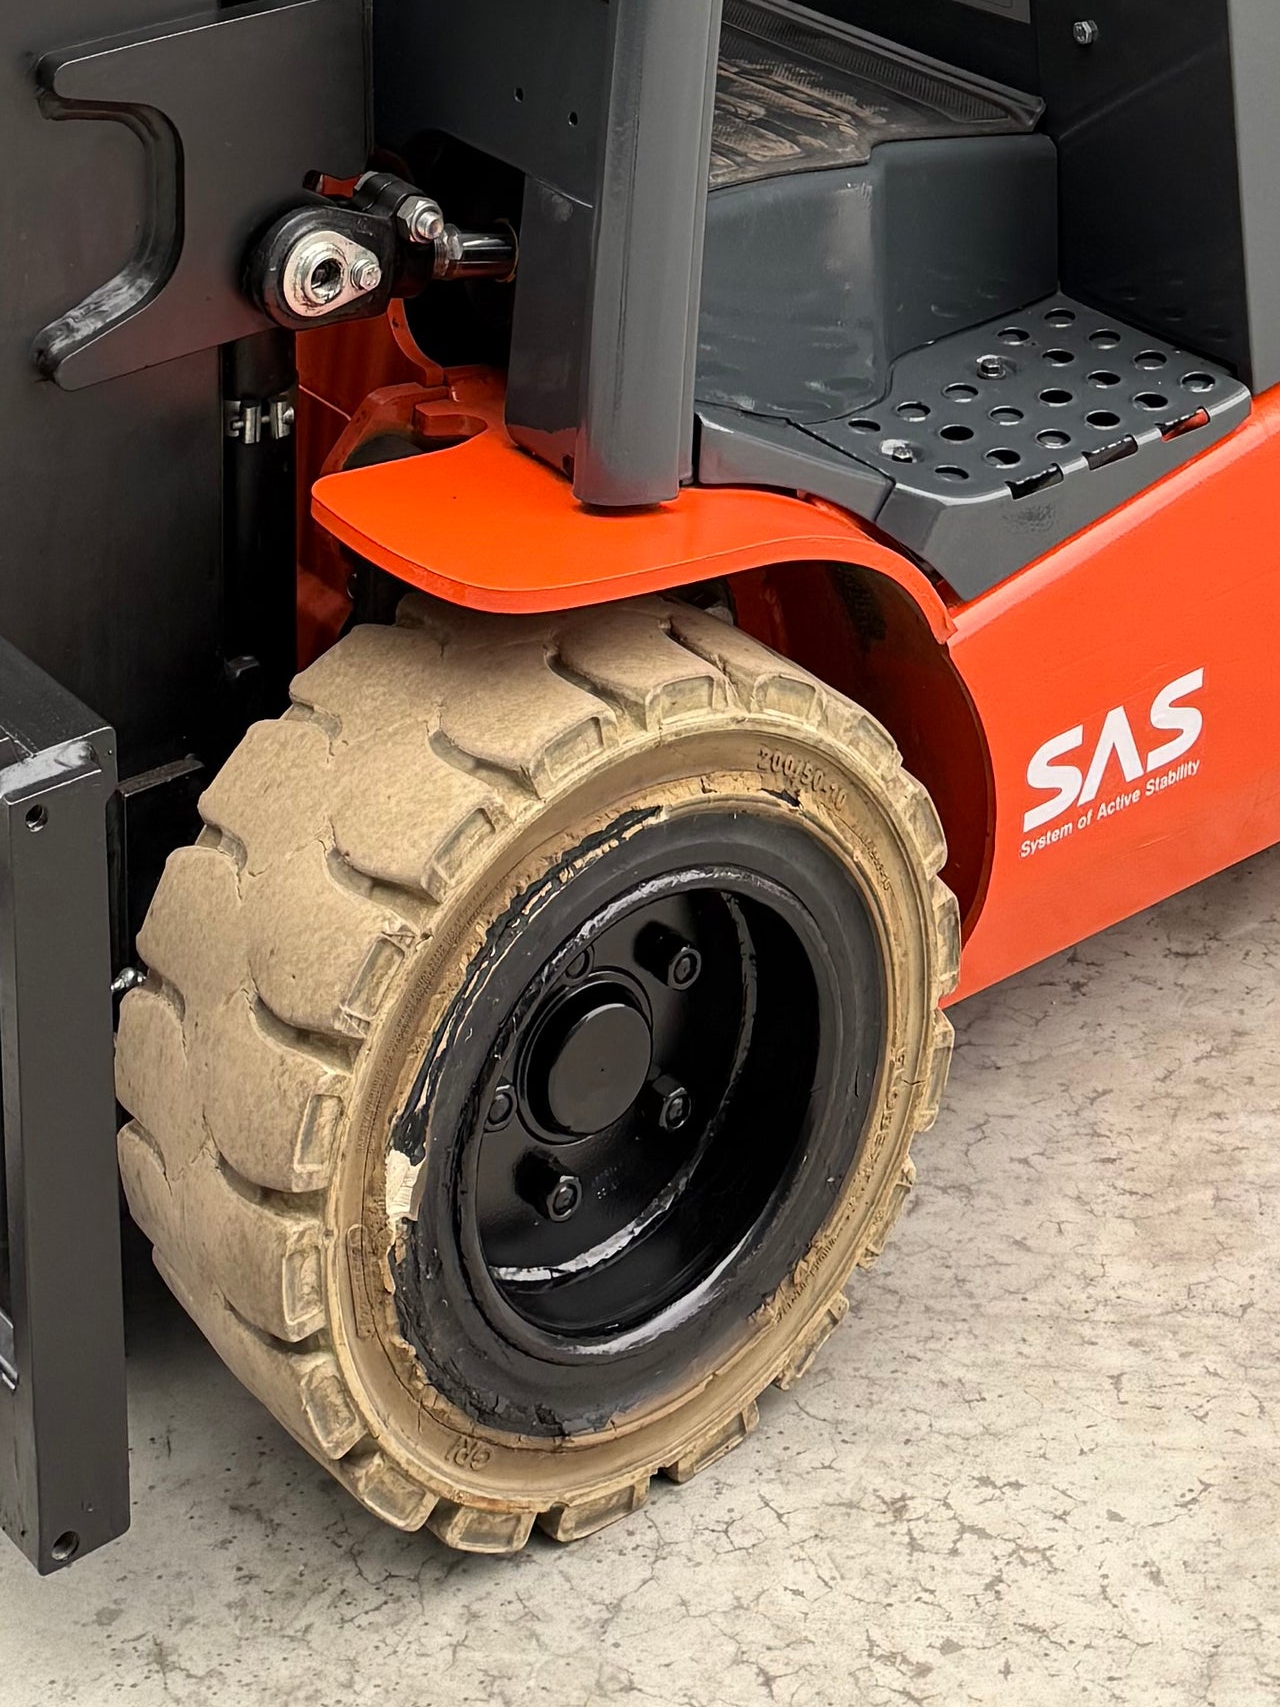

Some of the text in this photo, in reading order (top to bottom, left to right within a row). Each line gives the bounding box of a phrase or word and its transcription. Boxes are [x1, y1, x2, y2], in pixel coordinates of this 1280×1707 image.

[1020, 759, 1201, 858] System of Active Stability
[1023, 666, 1204, 833] SAS
